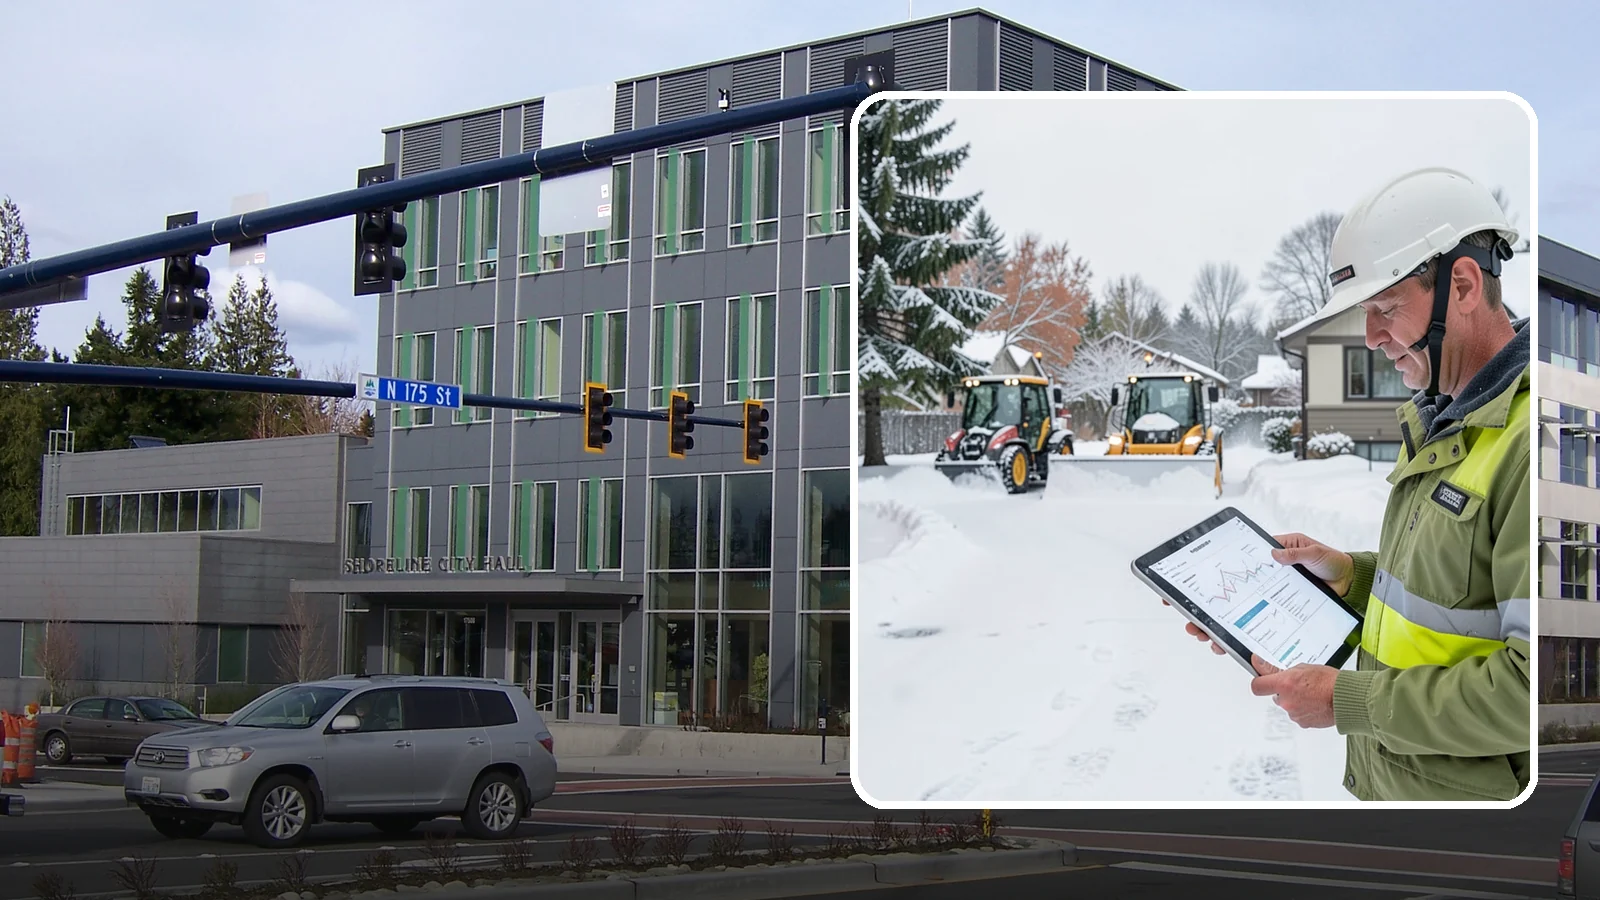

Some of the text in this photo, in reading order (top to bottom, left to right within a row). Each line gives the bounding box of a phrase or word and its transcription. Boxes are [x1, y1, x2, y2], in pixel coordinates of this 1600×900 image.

[387, 380, 451, 406] N 175 St
[344, 555, 526, 574] SHORELINE CITY HALL
